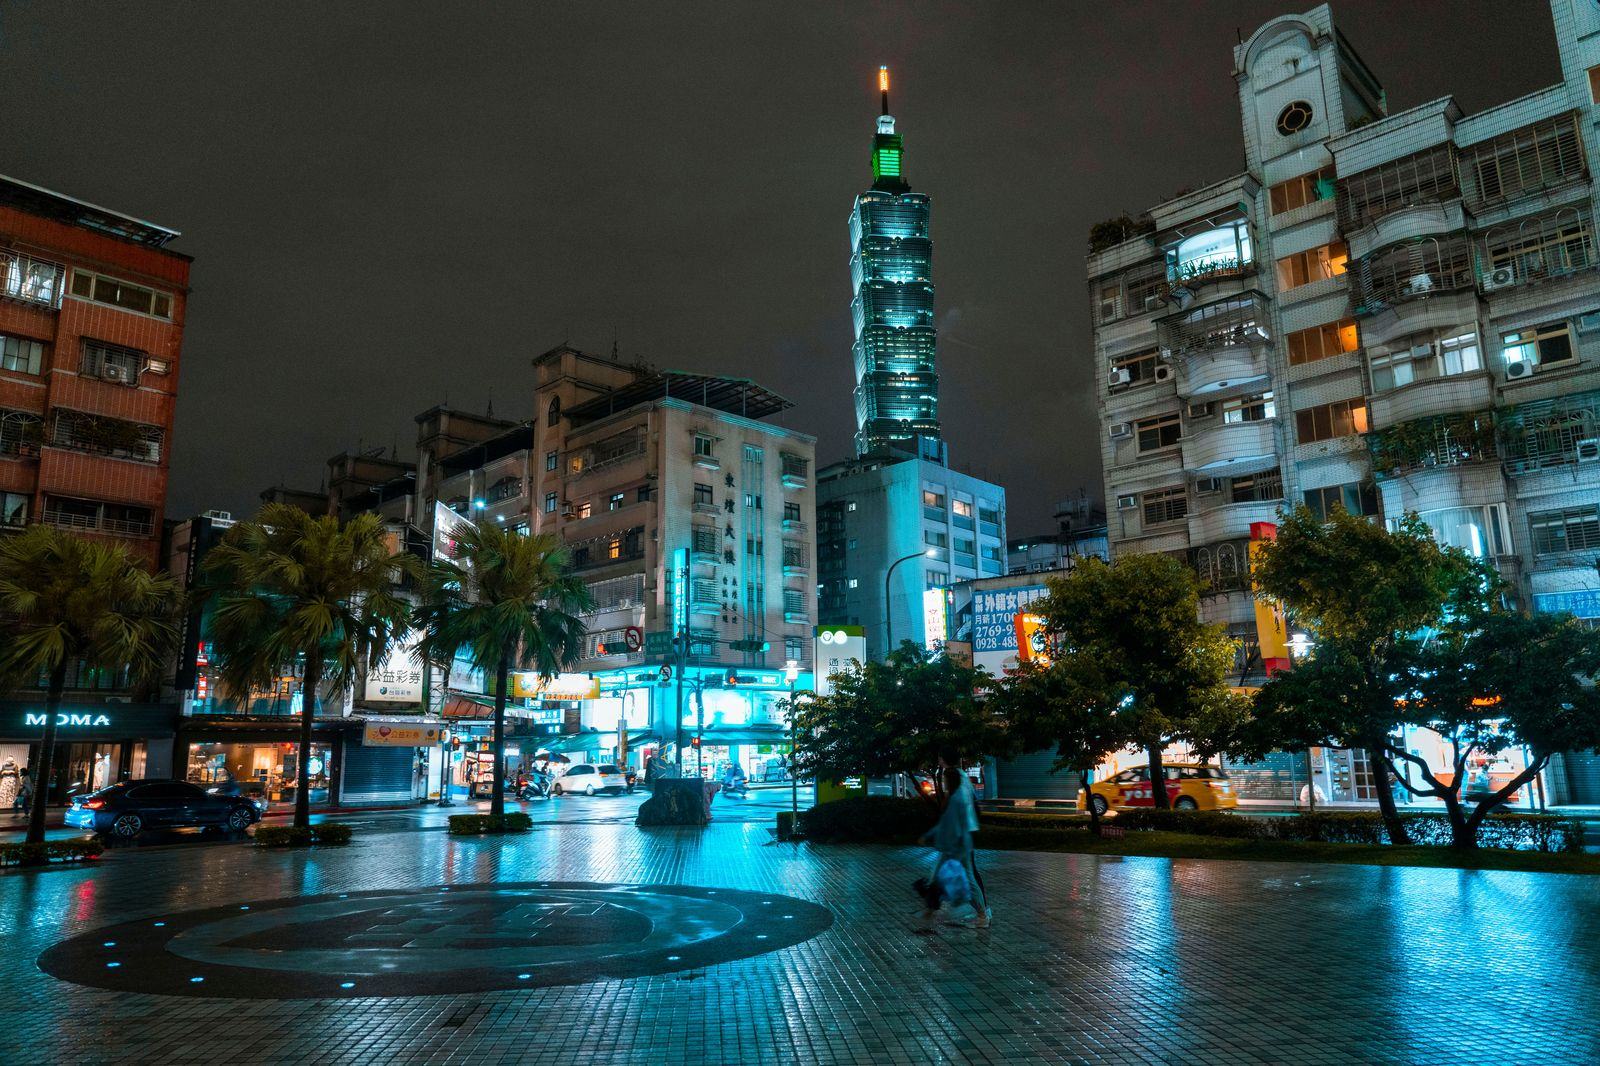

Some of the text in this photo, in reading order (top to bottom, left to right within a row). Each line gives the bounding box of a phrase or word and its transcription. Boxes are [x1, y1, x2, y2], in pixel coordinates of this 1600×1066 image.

[368, 668, 421, 685] 公益彩券
[25, 713, 111, 726] MOMA
